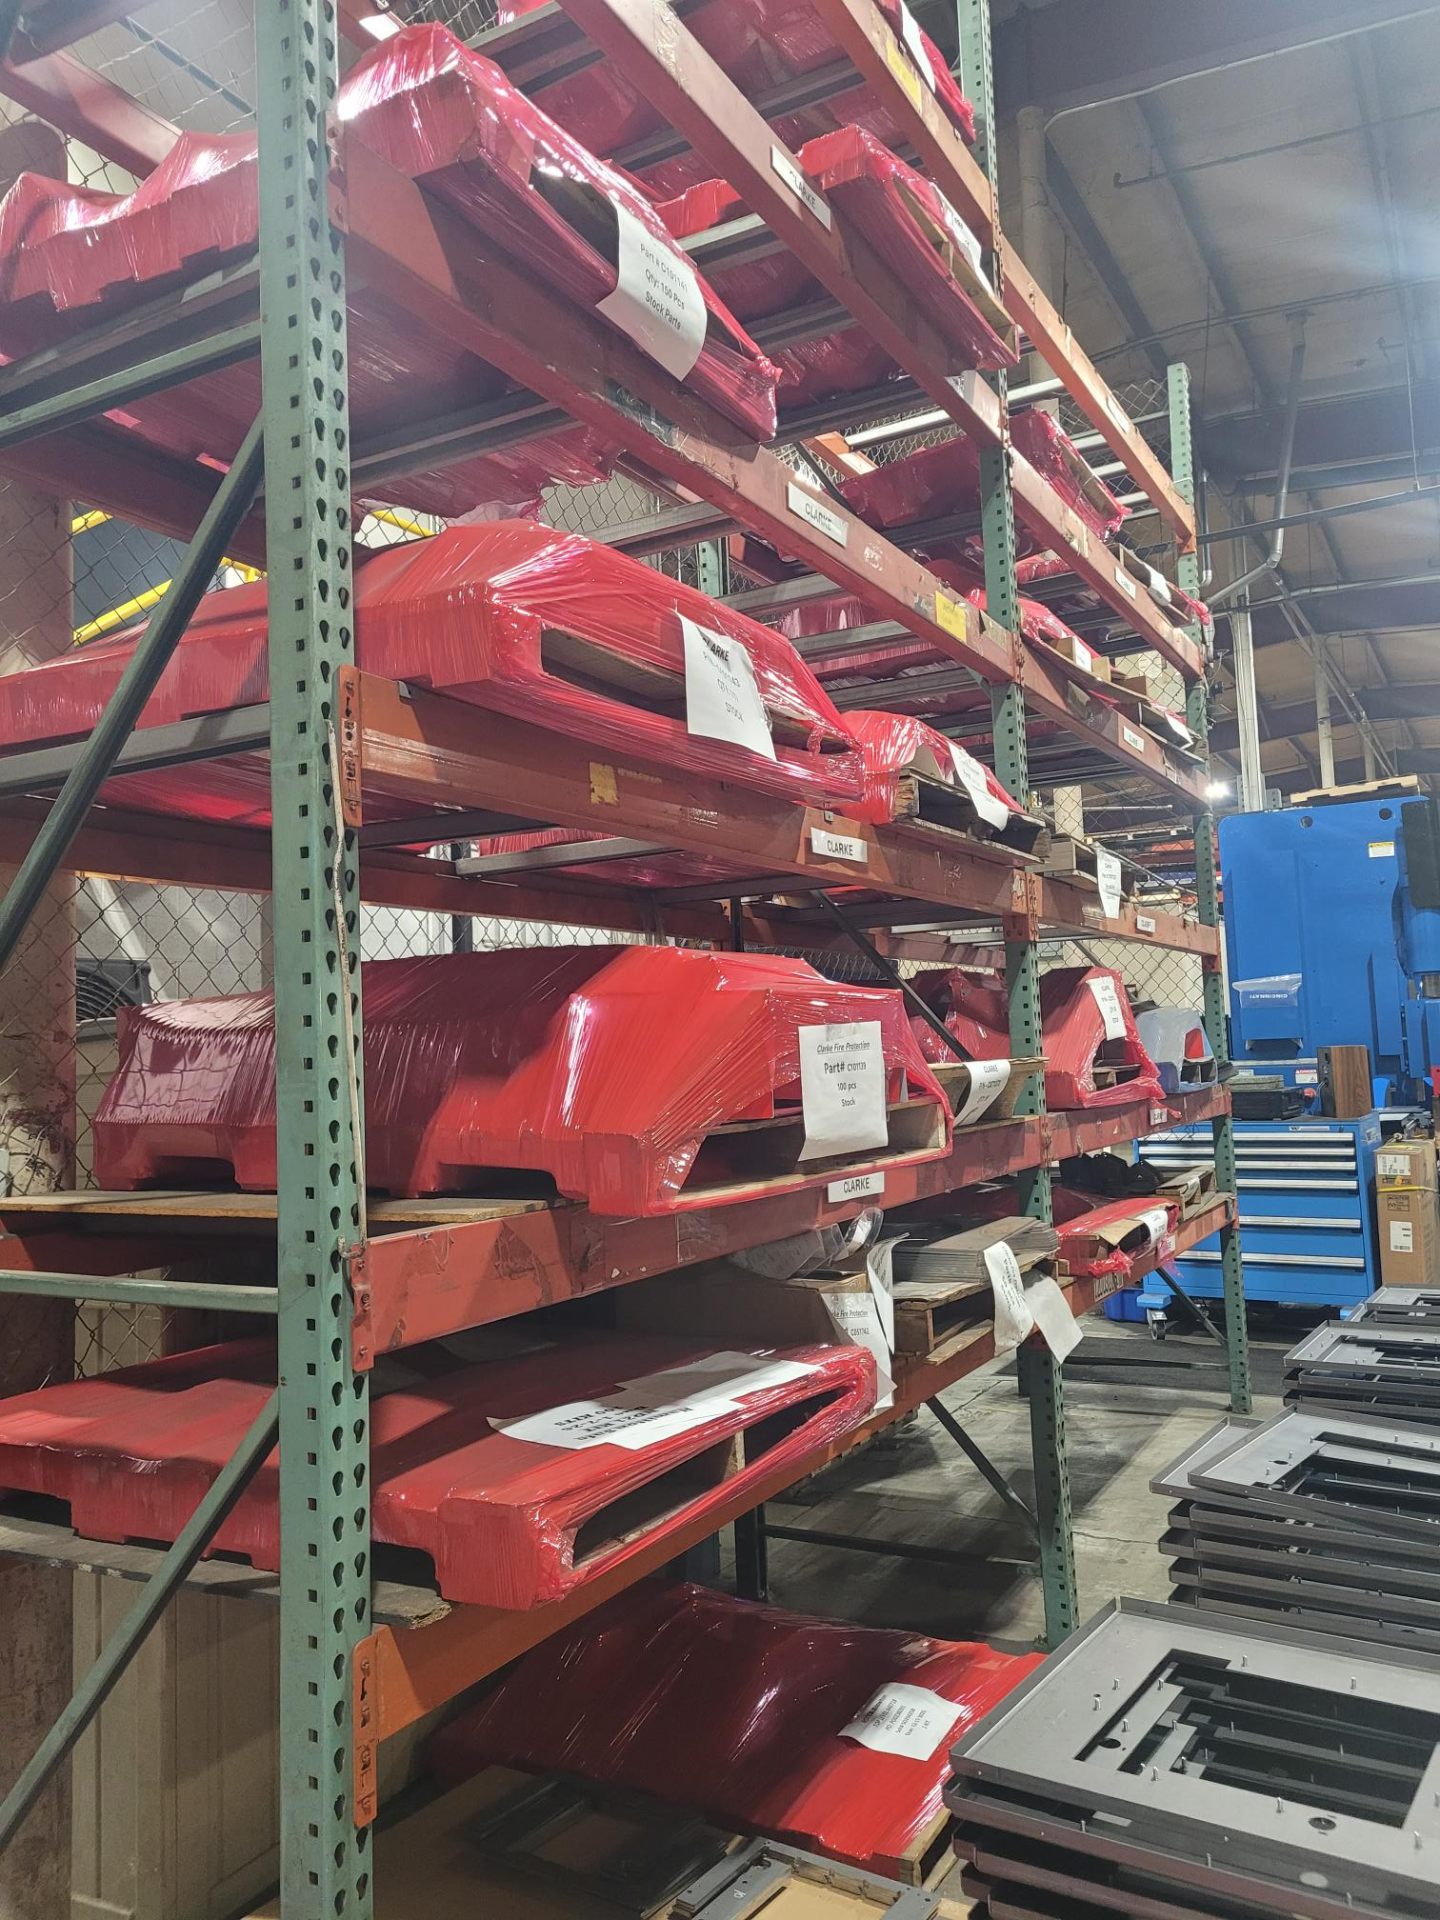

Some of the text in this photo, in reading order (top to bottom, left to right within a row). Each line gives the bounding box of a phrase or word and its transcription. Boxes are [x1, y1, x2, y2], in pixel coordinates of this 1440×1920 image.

[640, 243, 655, 263] Part
[645, 268, 661, 289] Qty:
[673, 292, 686, 310] Pcs
[645, 291, 682, 331] Stock Parts
[827, 839, 854, 856] CLARKE
[816, 1040, 871, 1054] Clarke Fire Protection
[824, 1061, 846, 1075] Part#
[847, 1081, 857, 1092] pcs
[841, 1098, 857, 1108] Stock
[843, 1177, 871, 1194] CLARKE
[554, 1412, 592, 1426] KITS
